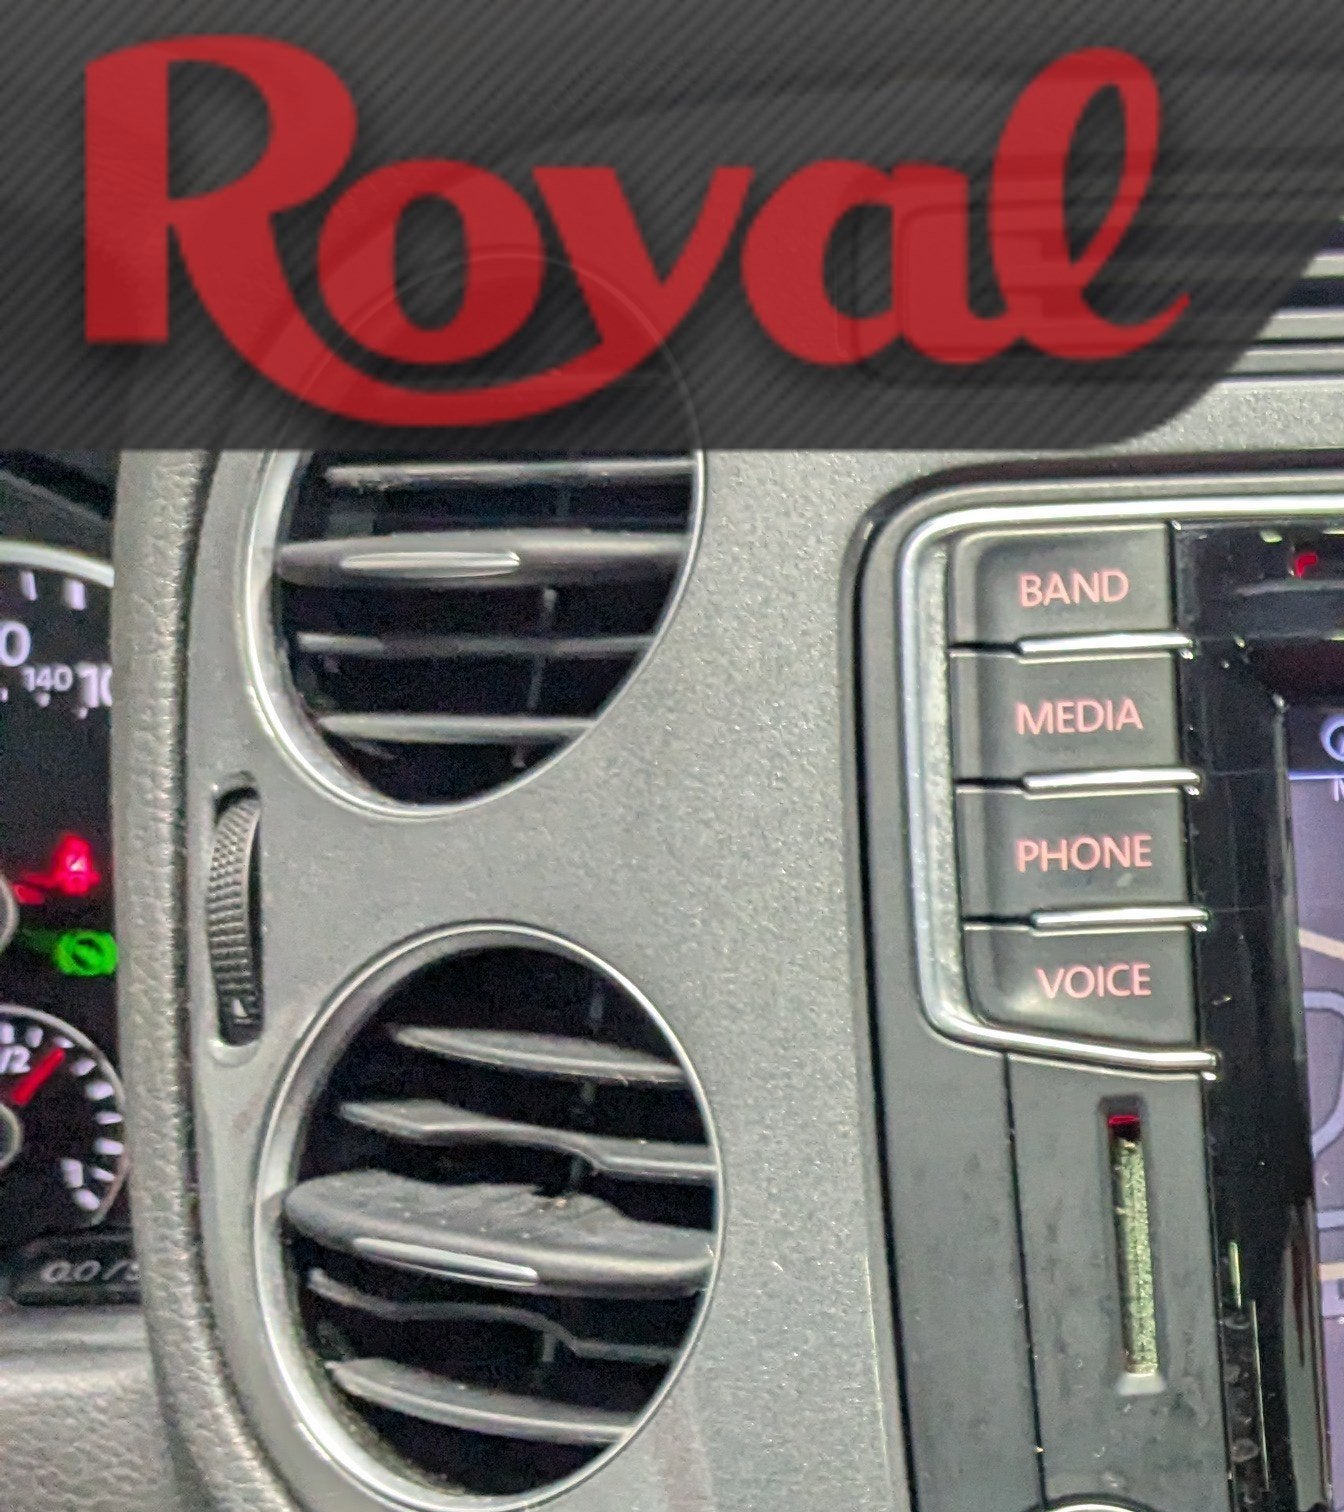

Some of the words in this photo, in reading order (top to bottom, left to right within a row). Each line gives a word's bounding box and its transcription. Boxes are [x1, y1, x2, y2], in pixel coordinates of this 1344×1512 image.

[1018, 567, 1129, 607] BAND
[22, 663, 73, 692] 140
[1014, 698, 1144, 737] MEDIA
[1014, 834, 1153, 872] PHONE
[1036, 963, 1152, 1000] VOICE
